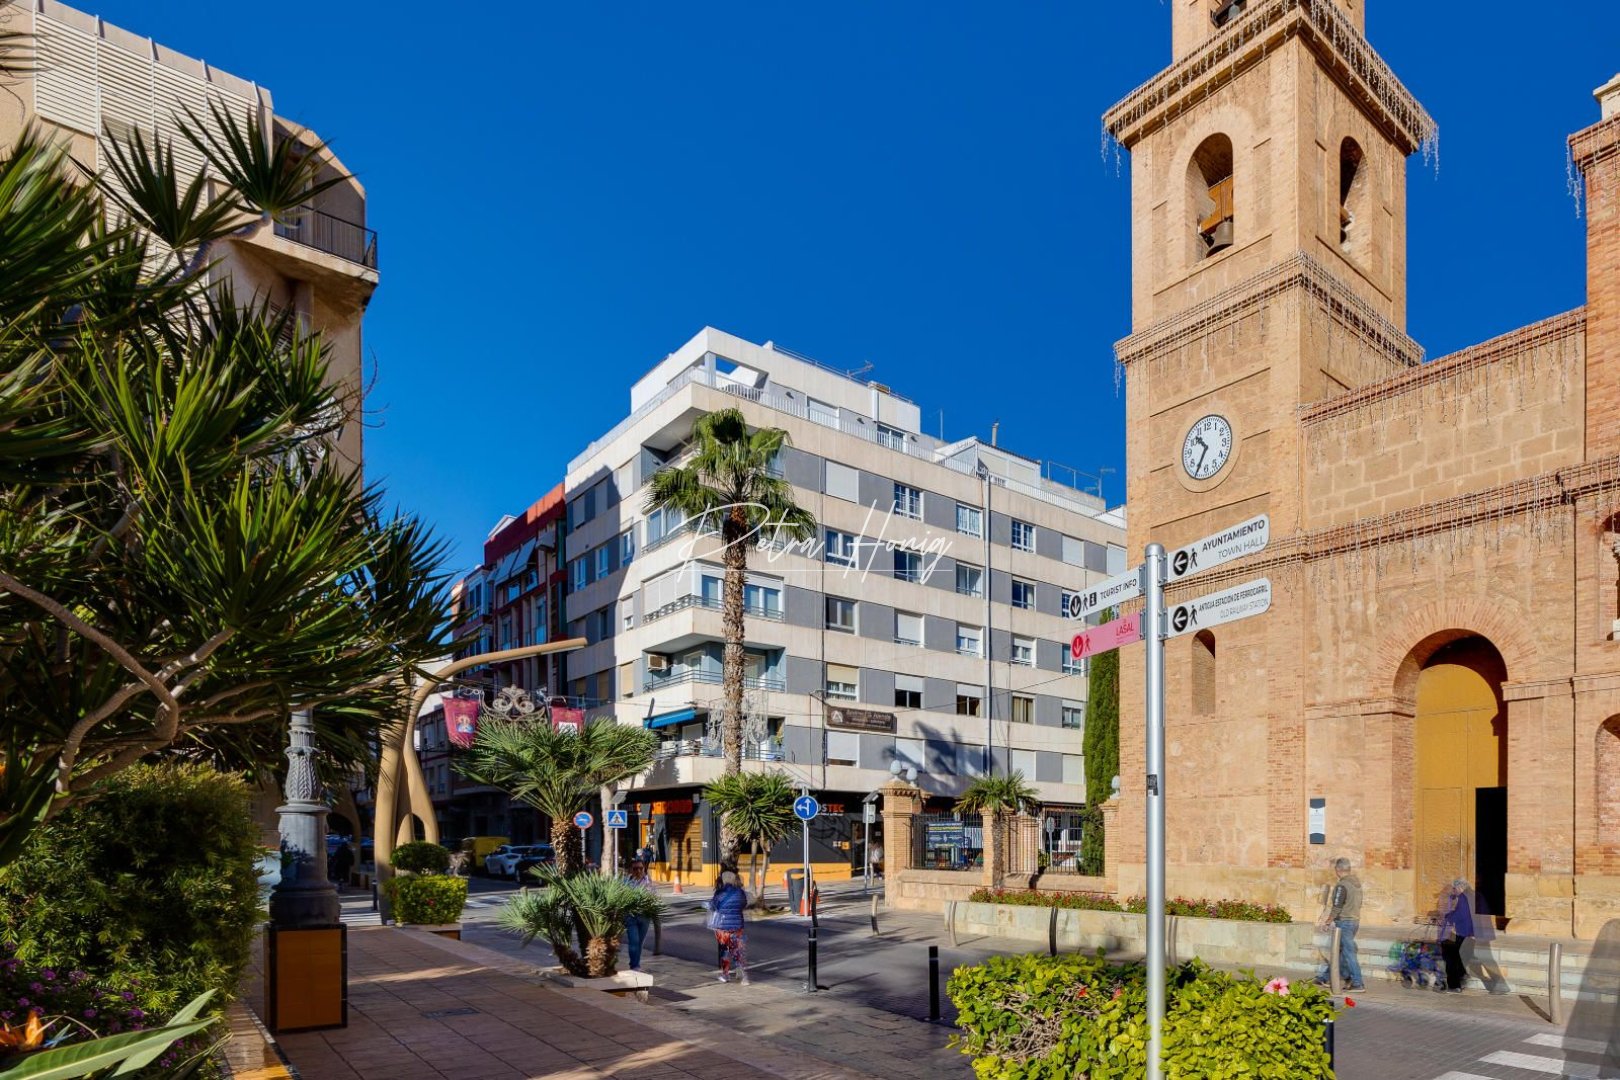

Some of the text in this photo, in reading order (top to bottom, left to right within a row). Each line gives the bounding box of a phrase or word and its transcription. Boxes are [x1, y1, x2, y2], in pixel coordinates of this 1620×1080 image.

[1204, 421, 1212, 431] 12
[1196, 427, 1202, 436] 11
[1219, 427, 1225, 436] 2
[1190, 437, 1198, 447] 10
[1221, 438, 1227, 447] 3
[1187, 448, 1193, 458] 9
[1190, 459, 1195, 468] 8
[1212, 459, 1217, 468] 5
[1204, 464, 1209, 473] 6
[1202, 519, 1265, 552] AYUNTAMIENTO
[1218, 536, 1265, 560] TOWN HALL
[1100, 578, 1137, 600] TOURIST INFO
